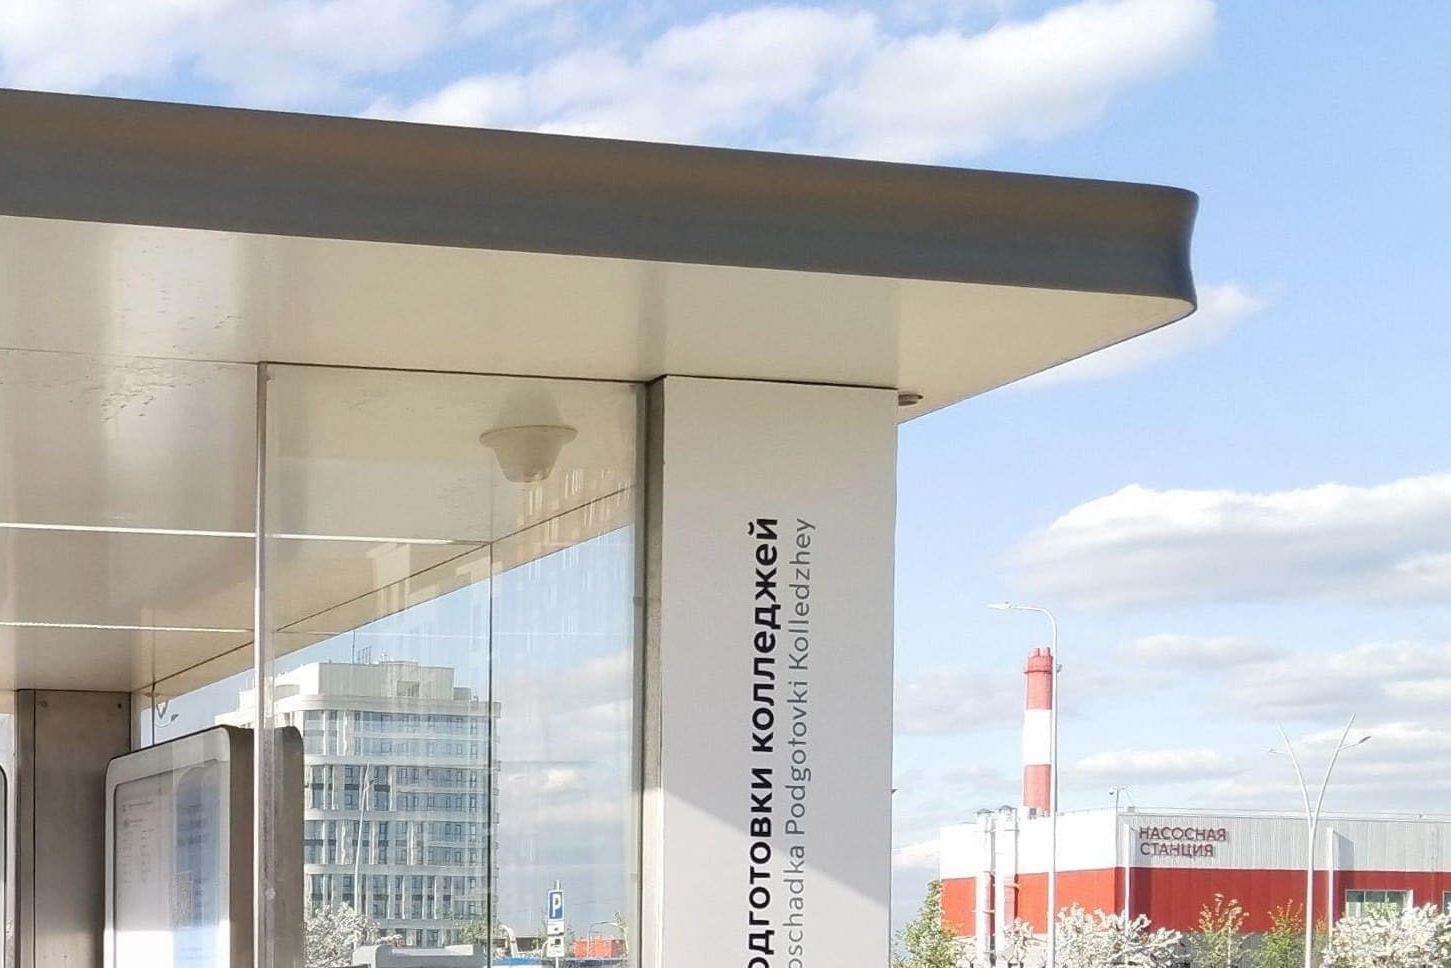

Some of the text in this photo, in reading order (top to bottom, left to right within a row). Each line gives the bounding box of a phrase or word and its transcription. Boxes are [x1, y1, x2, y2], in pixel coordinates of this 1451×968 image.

[747, 518, 781, 752] колледжей
[788, 518, 816, 670] Kolledzhey
[785, 681, 811, 835] Podgotovki
[1139, 826, 1227, 841] НАСОСНАЯ
[1140, 842, 1214, 858] СТАНЦИЯ
